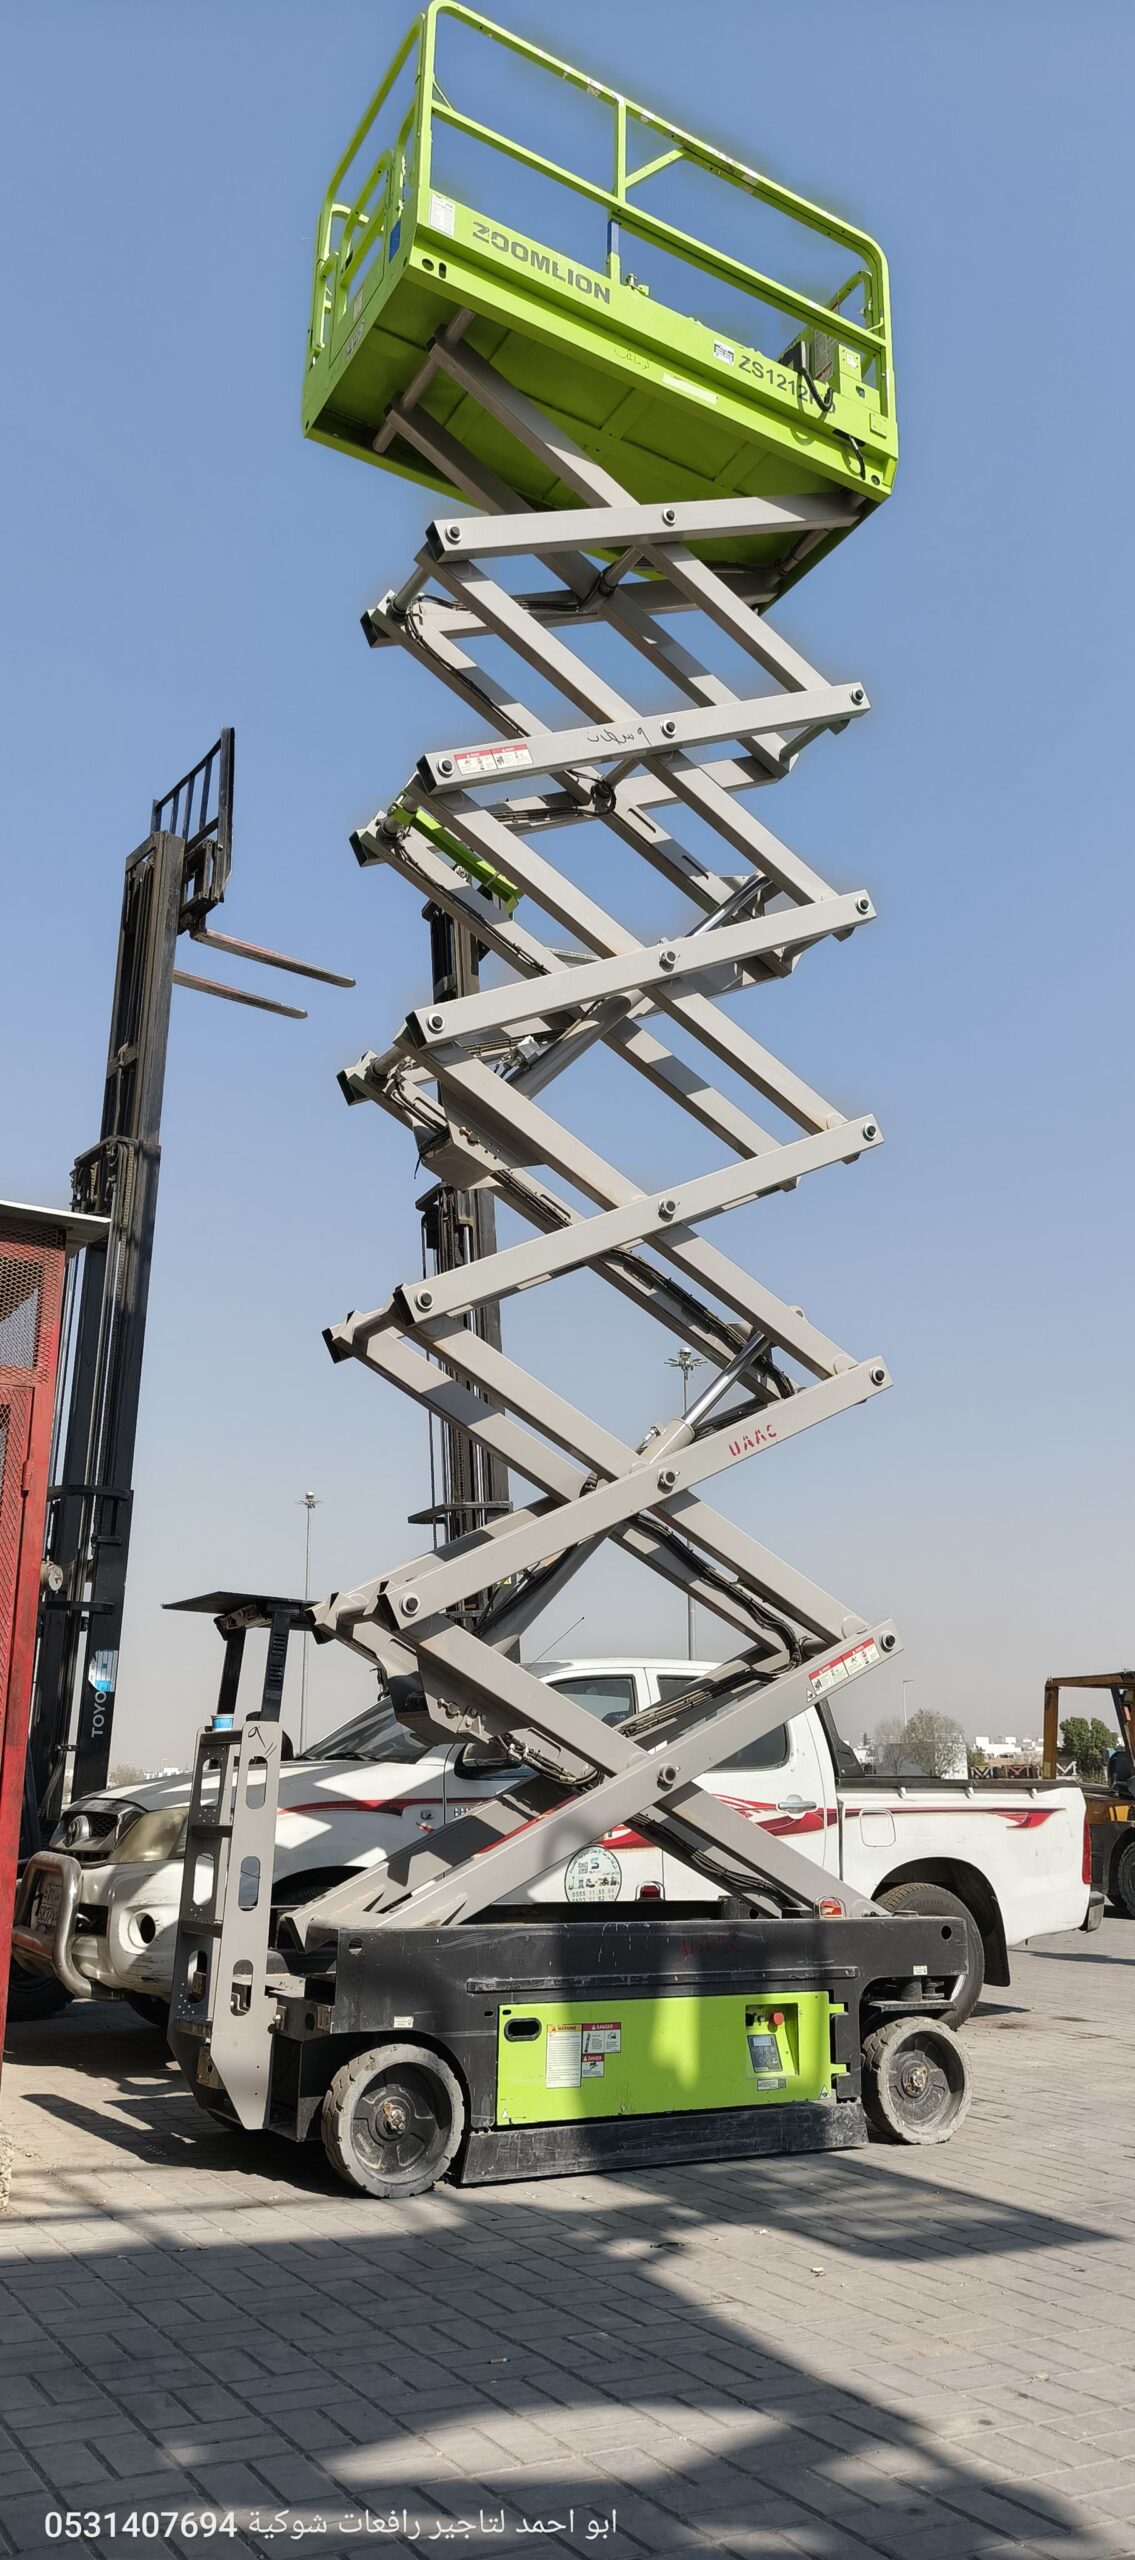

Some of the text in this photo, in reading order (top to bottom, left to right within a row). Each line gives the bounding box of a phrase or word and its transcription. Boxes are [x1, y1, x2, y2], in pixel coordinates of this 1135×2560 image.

[472, 221, 610, 305] ZOOMLION
[738, 355, 836, 414] ZS1212
[91, 1691, 106, 1738] TOYO
